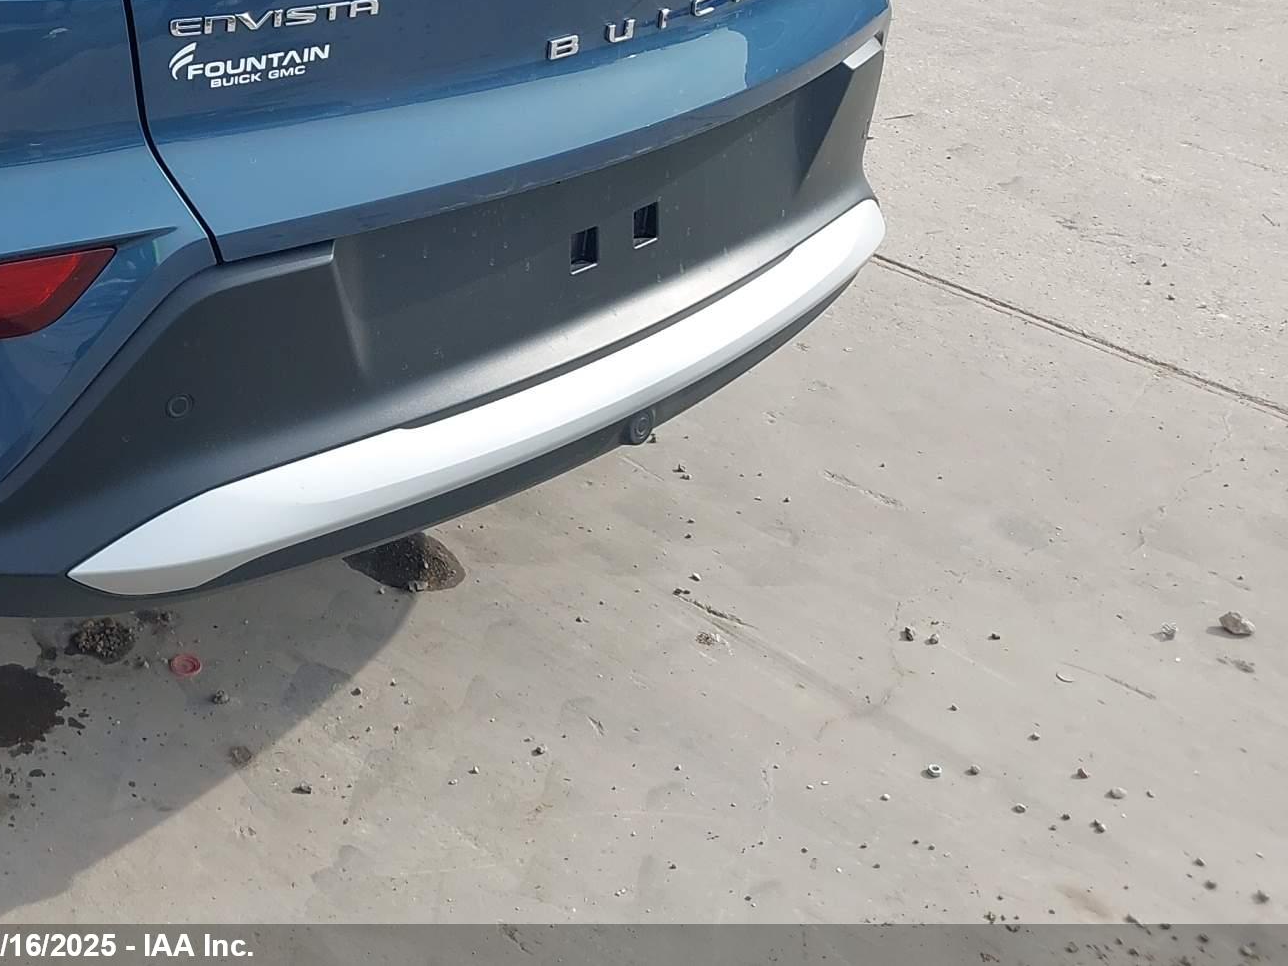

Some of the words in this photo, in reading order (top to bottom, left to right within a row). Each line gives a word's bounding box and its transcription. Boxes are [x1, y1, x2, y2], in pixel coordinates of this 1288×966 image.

[187, 43, 331, 80] FOUNTAIN
[210, 72, 262, 88] BUICK
[267, 65, 306, 80] GMC
